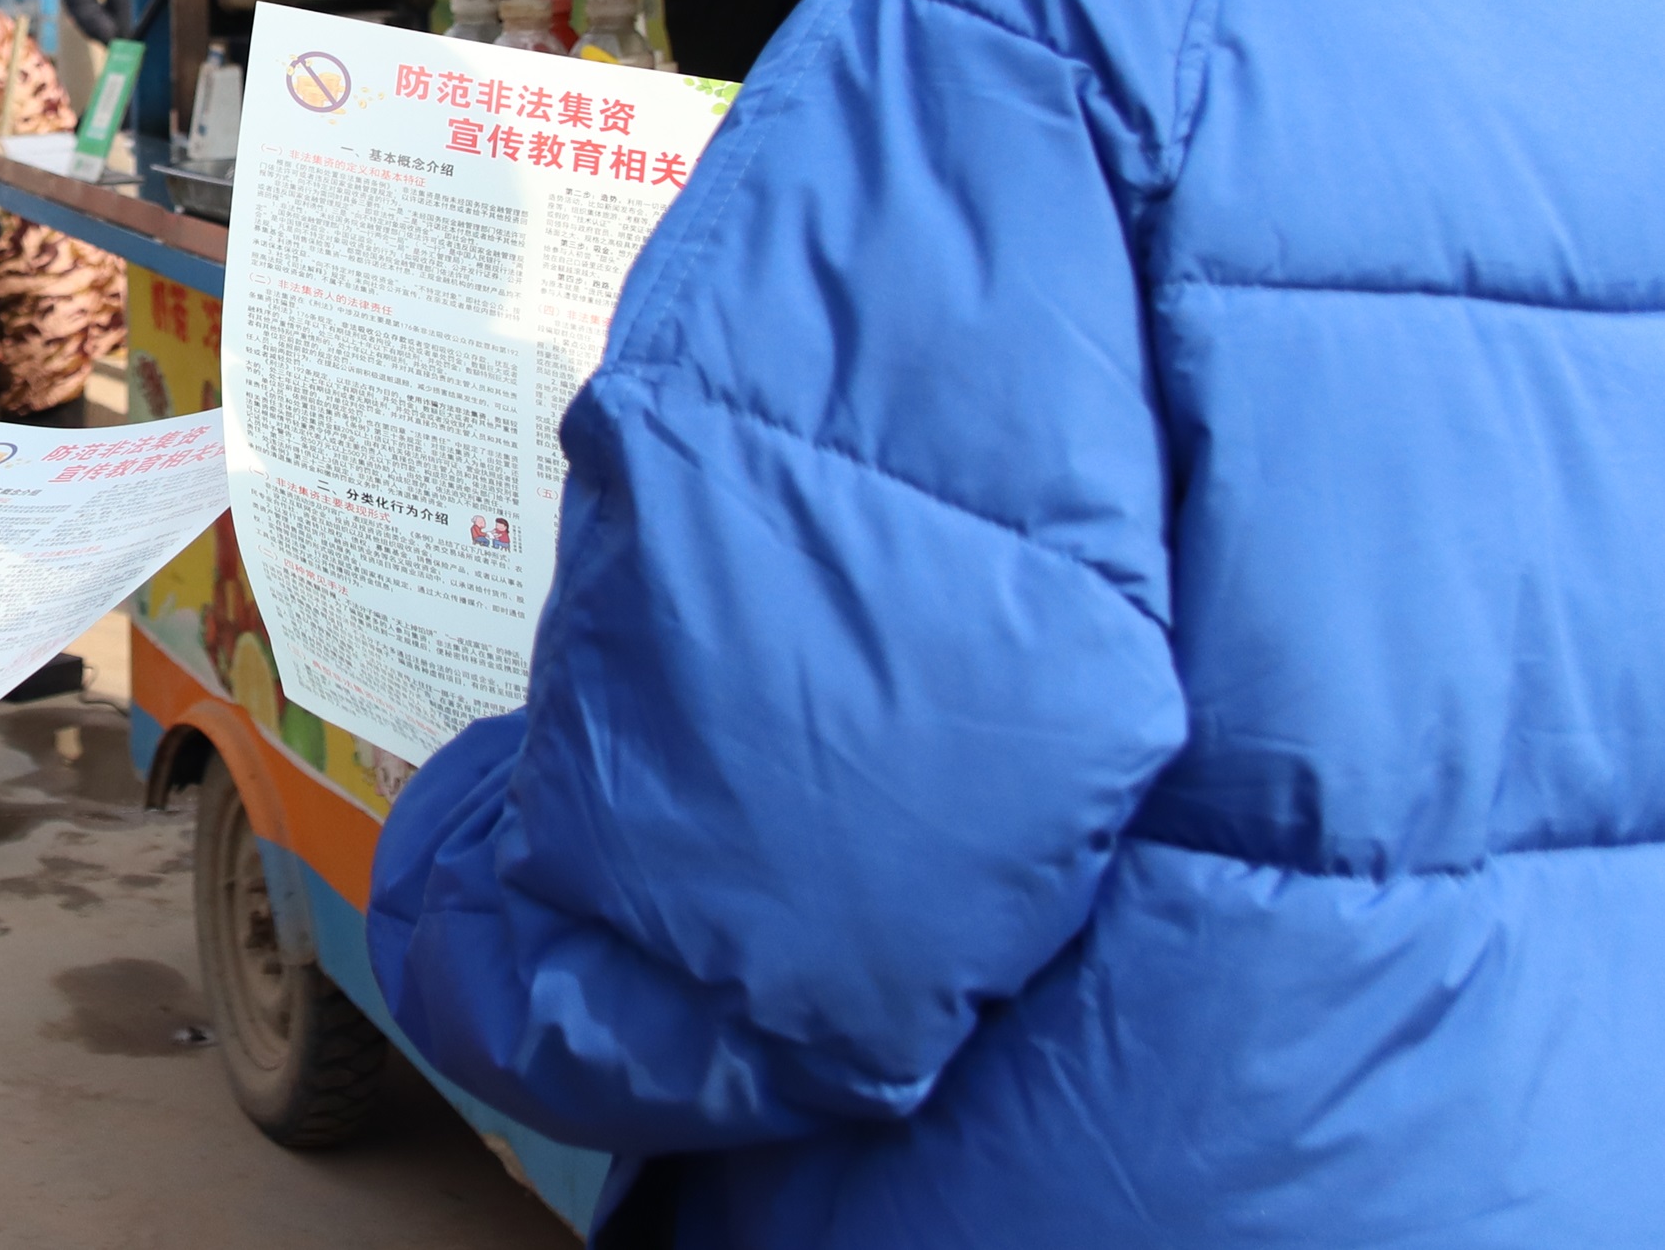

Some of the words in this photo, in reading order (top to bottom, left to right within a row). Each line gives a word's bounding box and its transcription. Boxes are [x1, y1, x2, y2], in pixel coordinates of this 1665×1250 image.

[395, 64, 636, 136] 防范非法集资
[260, 142, 426, 188] （一）非法集资的定义和基本特征
[340, 144, 454, 177] 一、基本概念介绍
[445, 118, 697, 190] 宣传教育相关
[248, 271, 391, 315] （二）非法集资人的法律责任
[41, 425, 212, 462] 防范非法集资
[315, 478, 449, 526] 二、分类化行为介绍
